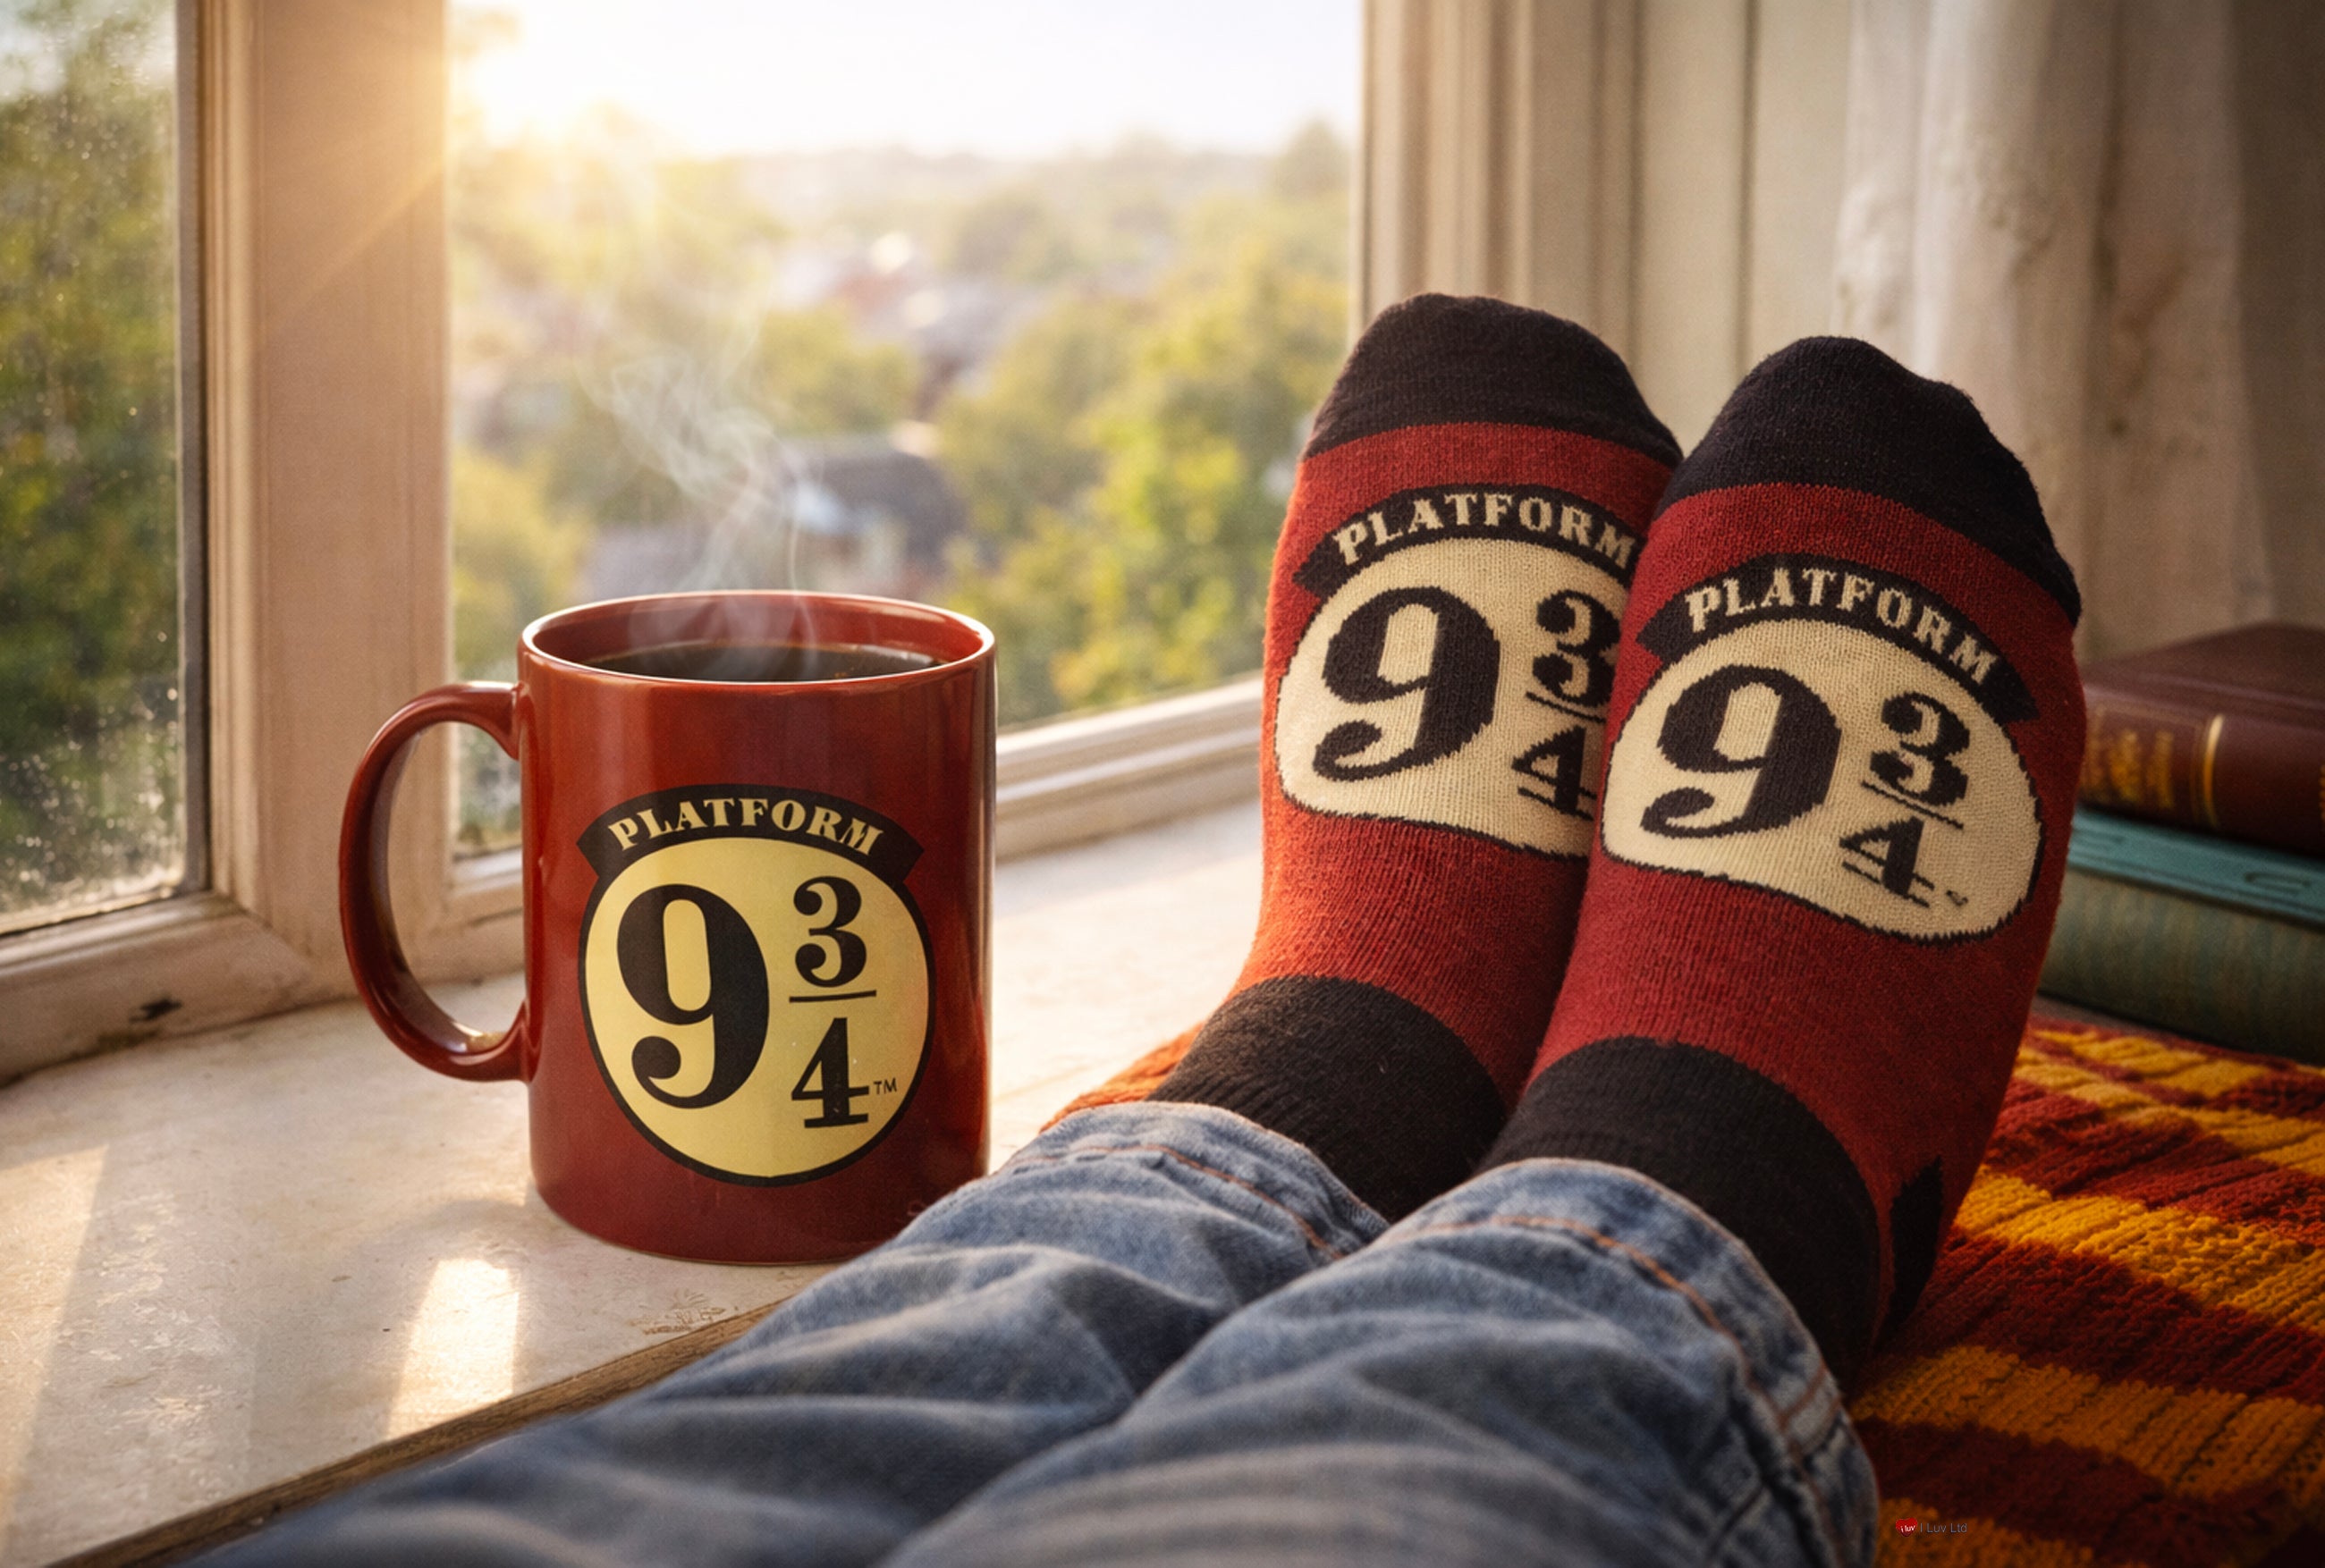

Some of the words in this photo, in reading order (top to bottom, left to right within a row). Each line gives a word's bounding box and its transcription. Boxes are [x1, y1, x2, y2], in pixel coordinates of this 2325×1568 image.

[1332, 493, 1636, 569] PLATFORM
[1312, 586, 1501, 782] 9
[1685, 568, 2000, 685] PLATFORM
[1640, 664, 1842, 839] 9
[608, 797, 884, 856] PLATFORM
[617, 883, 770, 1109] 9
[874, 1078, 898, 1095] TM
